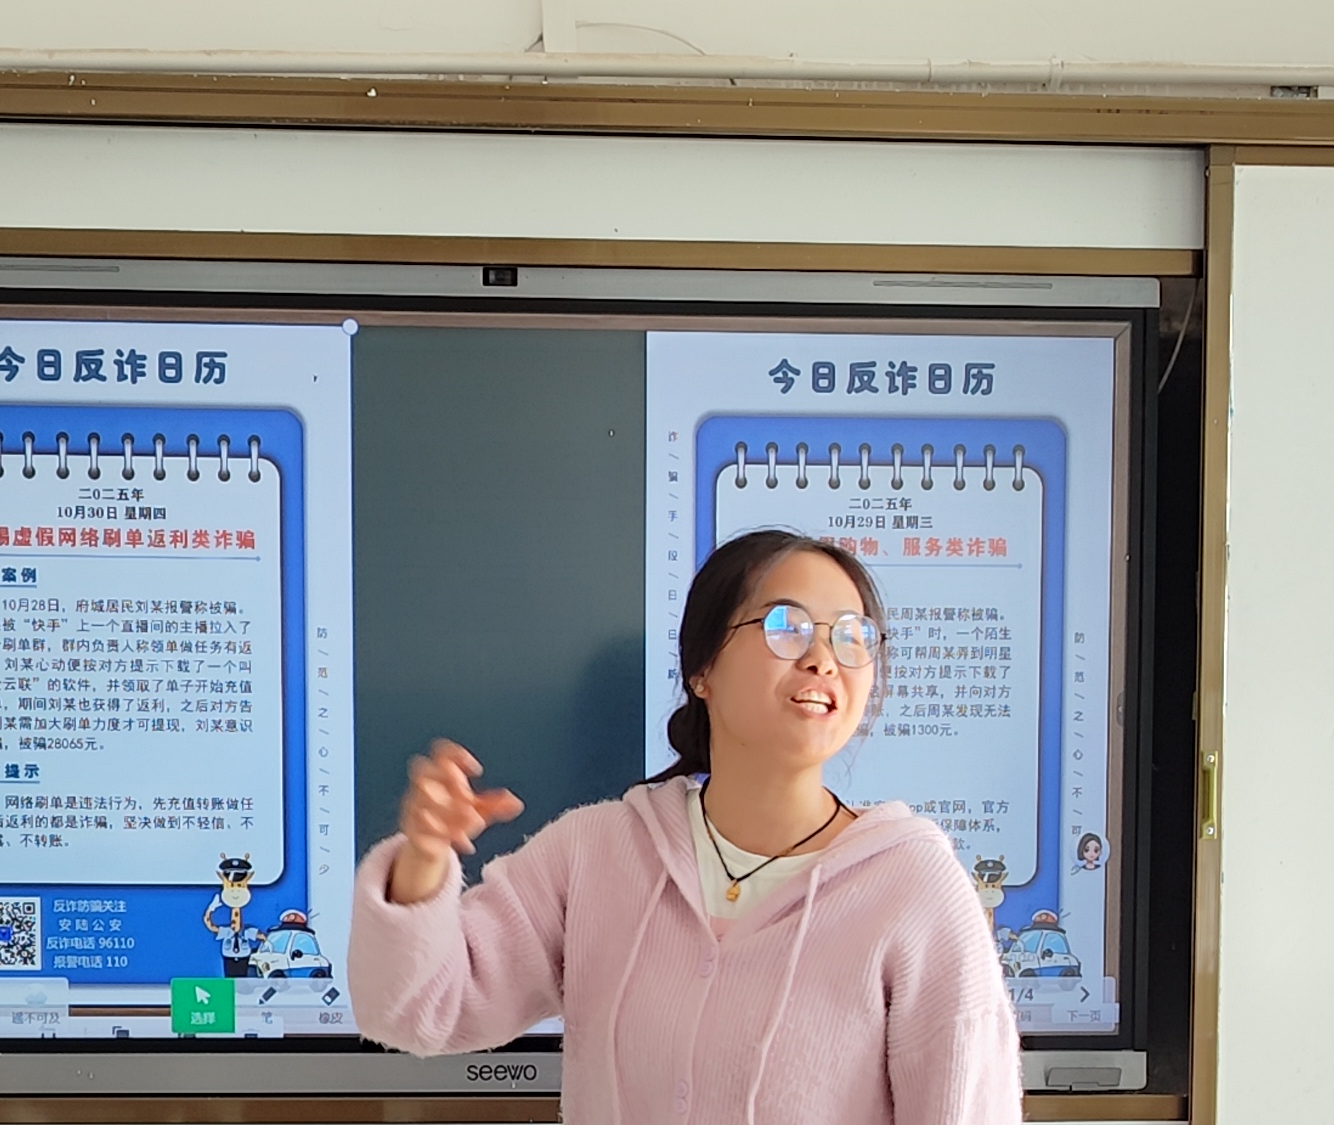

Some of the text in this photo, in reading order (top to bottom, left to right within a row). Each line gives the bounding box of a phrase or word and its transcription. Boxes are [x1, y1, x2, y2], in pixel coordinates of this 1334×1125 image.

[768, 358, 996, 396] 今日反诈日历
[57, 505, 167, 520] 10月30日 星期四
[828, 516, 933, 529] 10月29日 星期三
[53, 899, 127, 913] 反诈防骗关注
[46, 936, 135, 950] 反诈电话 96110
[53, 955, 128, 969] 报警电话 110
[1067, 1010, 1101, 1022] 下一页
[466, 1064, 538, 1082] seewo
